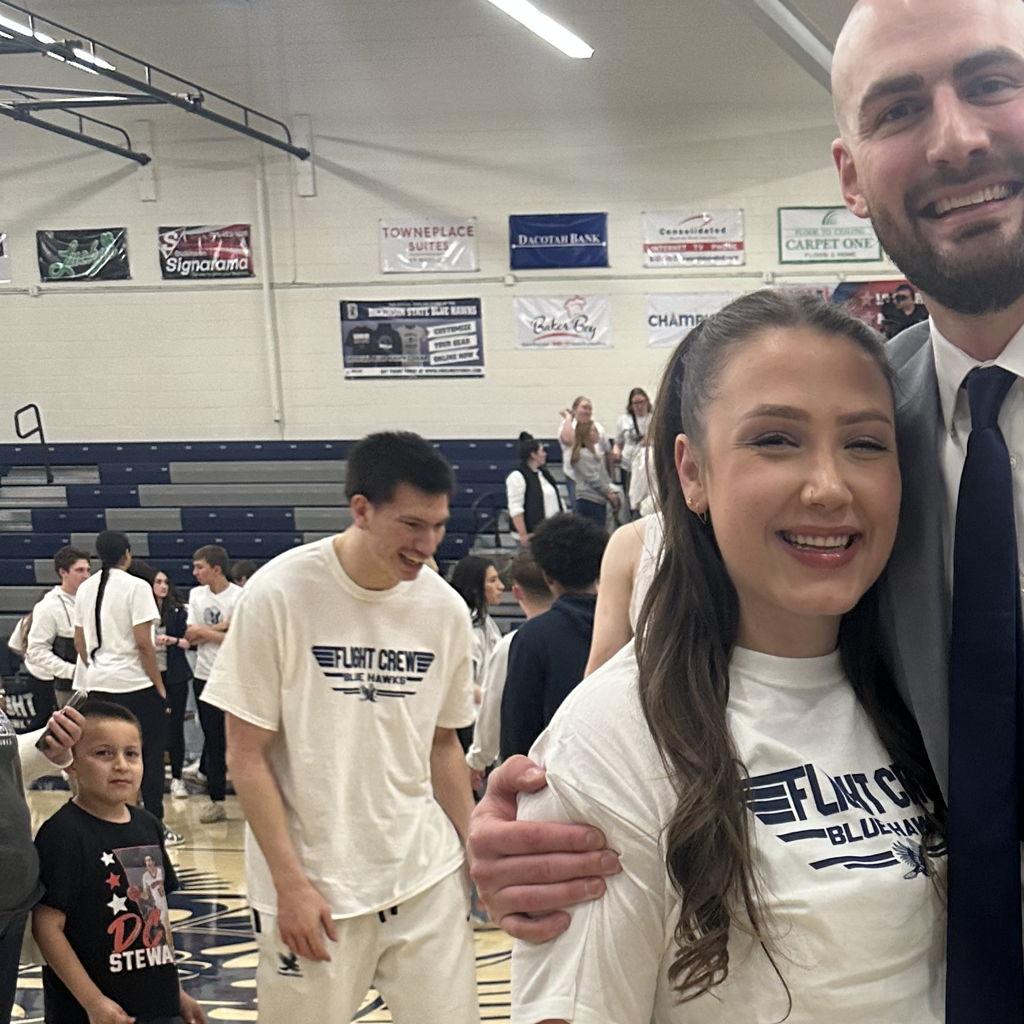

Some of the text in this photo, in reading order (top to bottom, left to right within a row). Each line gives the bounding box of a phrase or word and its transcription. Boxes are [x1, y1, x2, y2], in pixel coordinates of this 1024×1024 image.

[382, 226, 475, 239] TOWNEPLACE
[408, 241, 450, 252] SUITES
[785, 238, 873, 251] CARPET ONE
[166, 256, 248, 276] Signarama
[532, 315, 569, 335] Baker
[332, 646, 415, 672] FLIGHT CREW
[368, 673, 406, 685] HAWKS
[109, 945, 175, 973] STEWA
